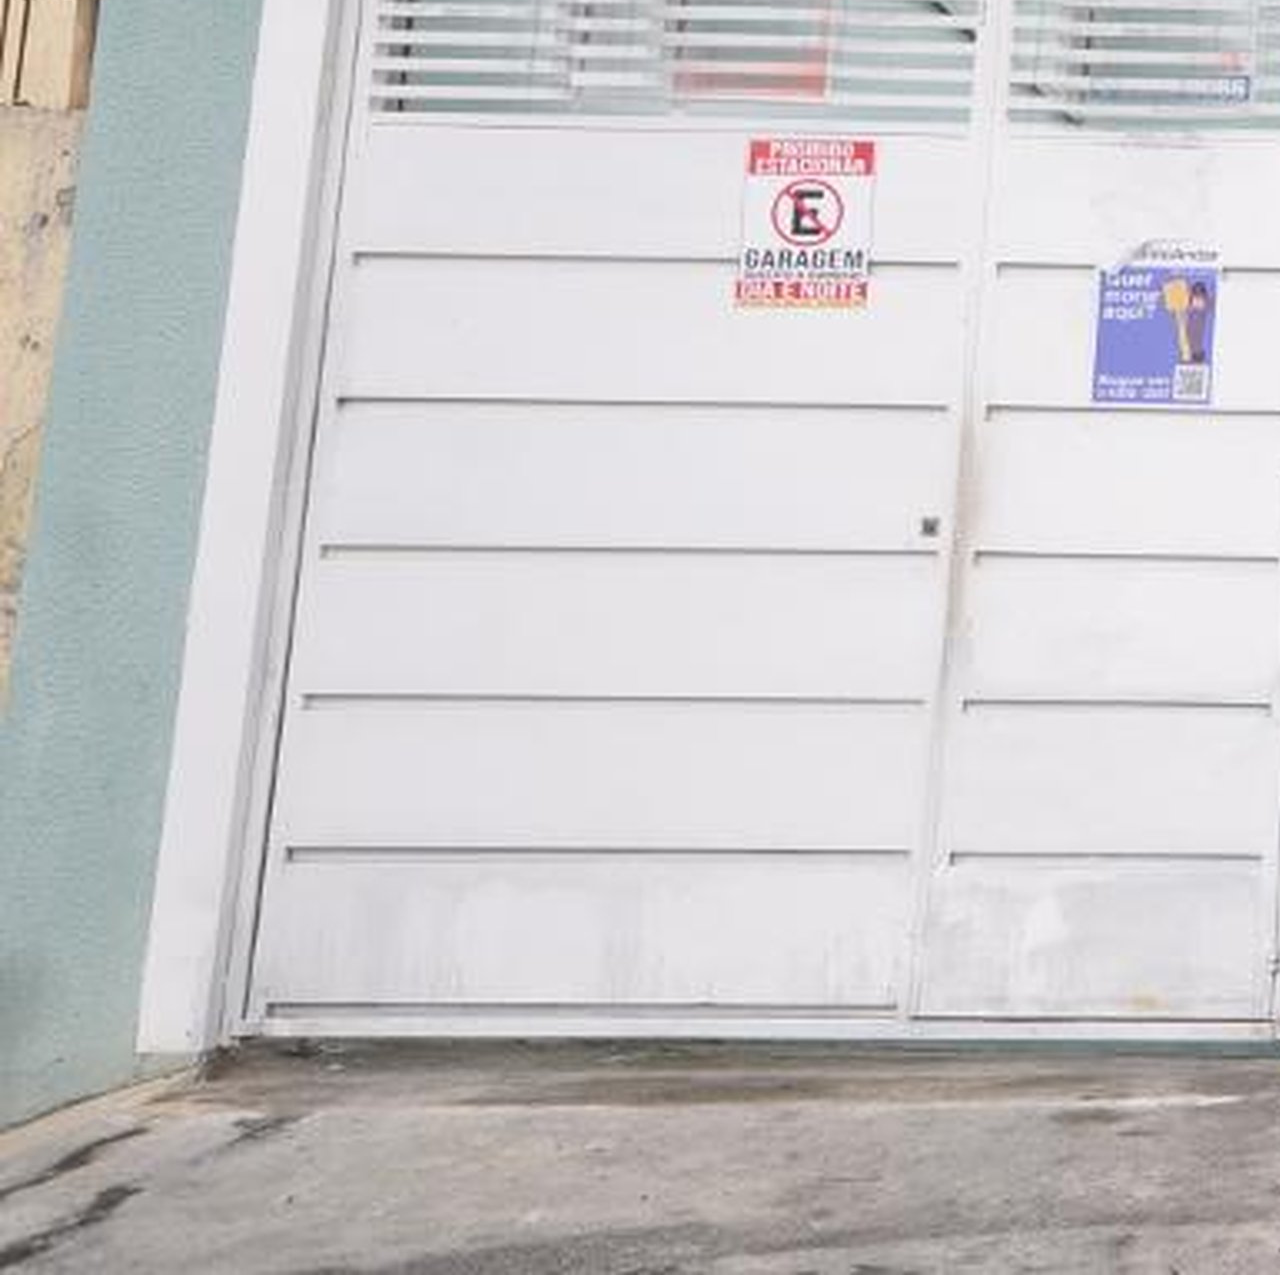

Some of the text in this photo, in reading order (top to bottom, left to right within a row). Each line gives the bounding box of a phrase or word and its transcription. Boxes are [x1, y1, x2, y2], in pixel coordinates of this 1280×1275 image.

[769, 141, 855, 158] PROIBIDO
[754, 157, 867, 174] ESTACIONAR
[744, 248, 864, 270] GARAGEM
[741, 281, 774, 299] DIA
[800, 282, 863, 300] NOITE
